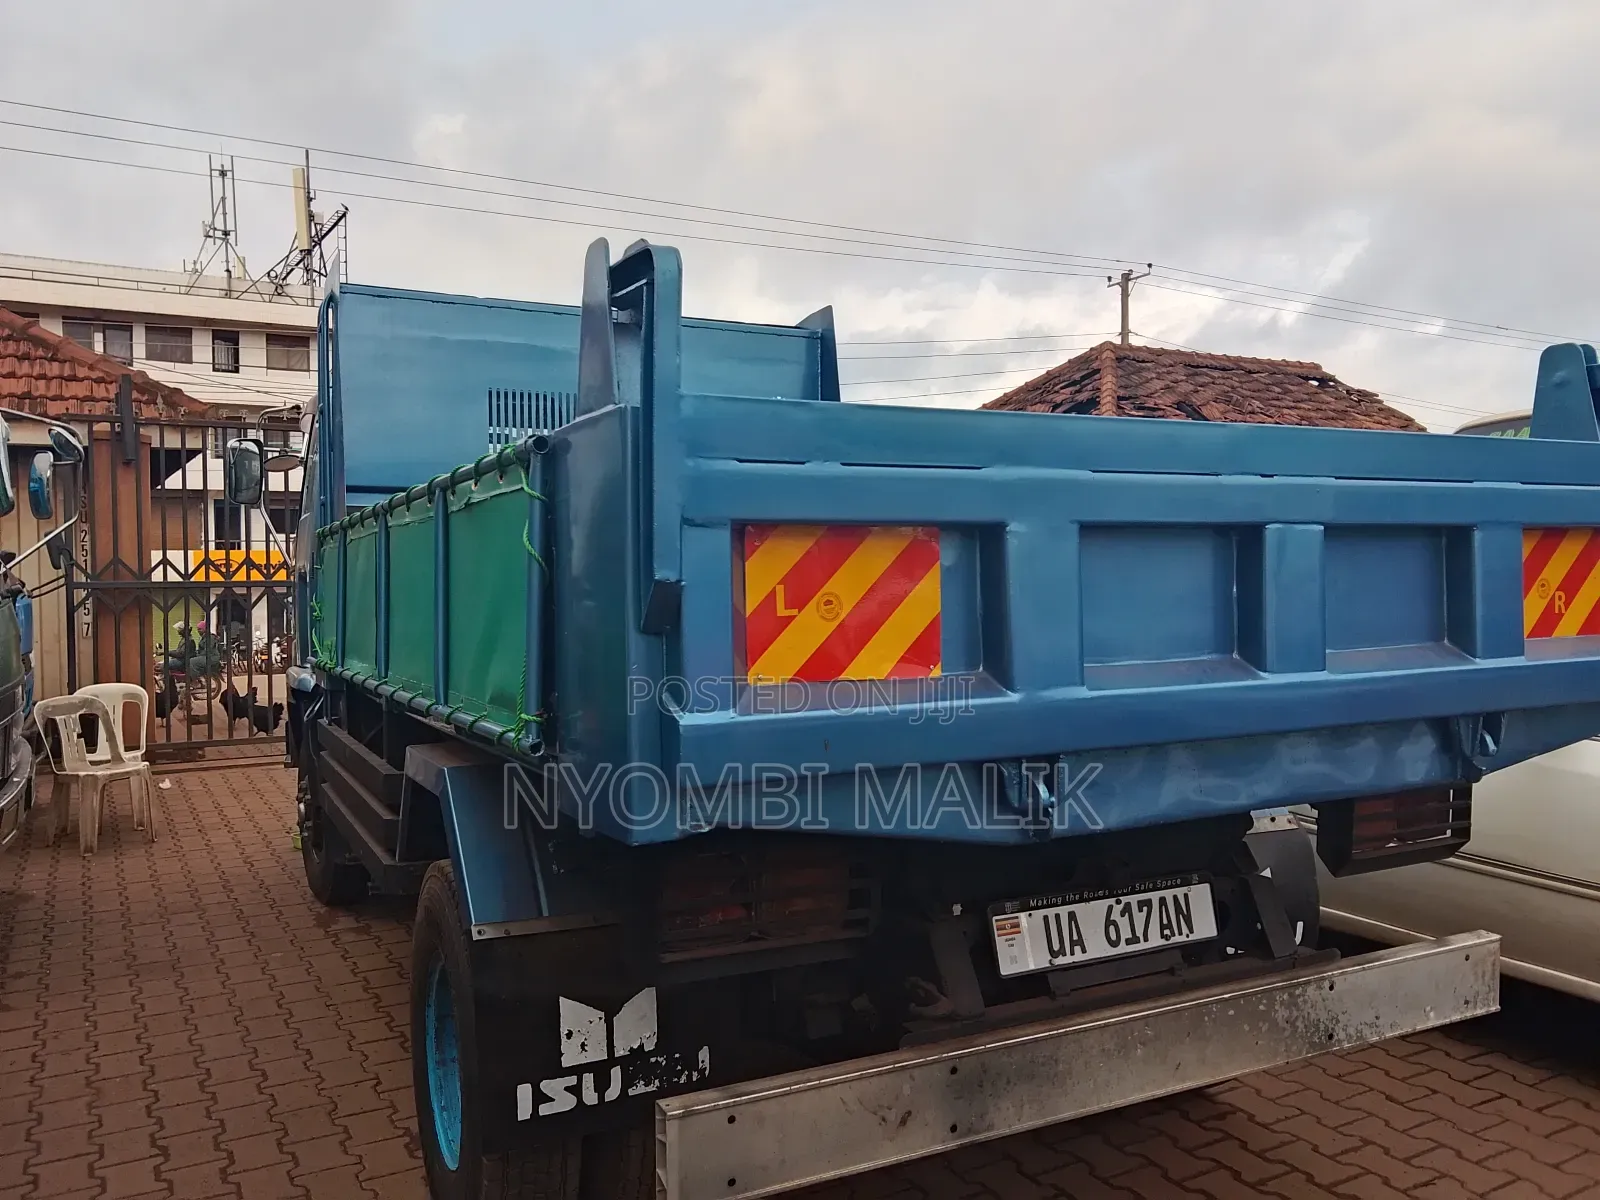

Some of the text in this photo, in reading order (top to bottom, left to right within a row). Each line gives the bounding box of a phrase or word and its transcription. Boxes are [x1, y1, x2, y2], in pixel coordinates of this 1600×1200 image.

[775, 584, 799, 617] L
[1554, 590, 1566, 614] R
[1029, 895, 1063, 908] Making
[1065, 892, 1080, 902] the
[1134, 881, 1154, 891] Safe
[1156, 878, 1182, 889] Space
[1042, 892, 1195, 959] UA 617AN
[516, 1045, 710, 1122] ISU
